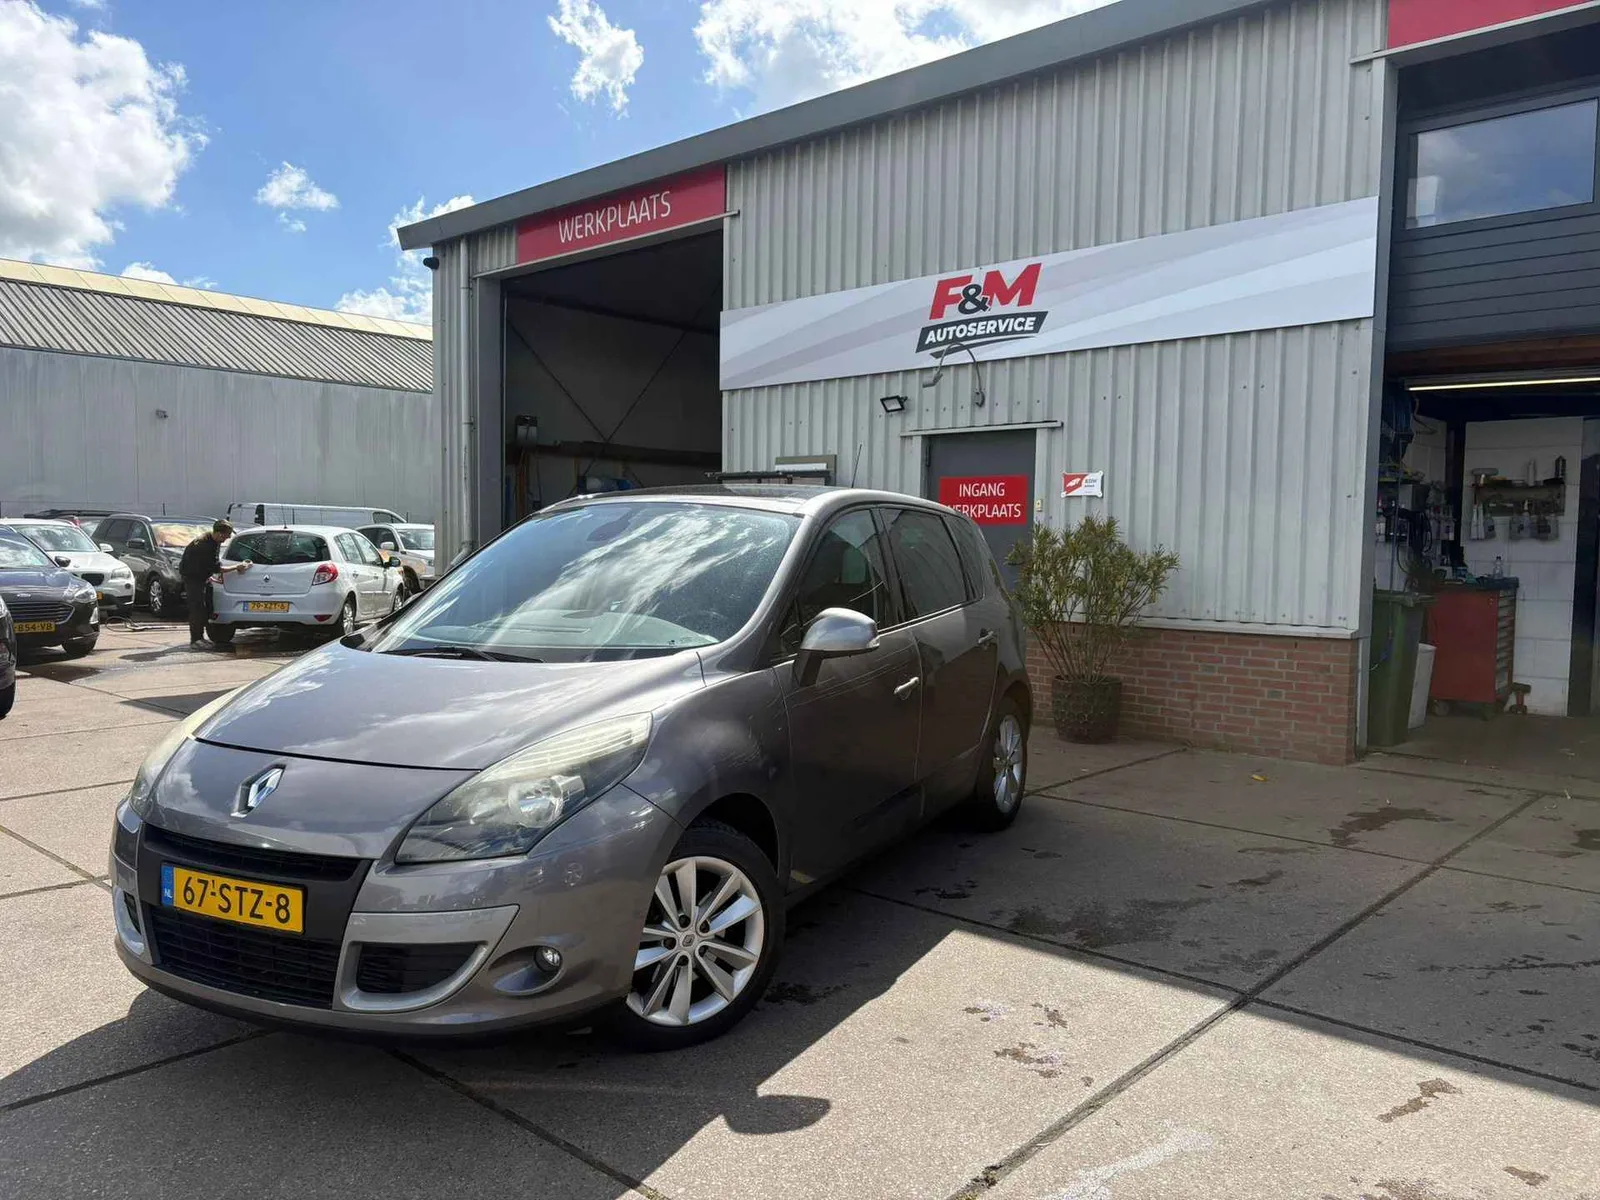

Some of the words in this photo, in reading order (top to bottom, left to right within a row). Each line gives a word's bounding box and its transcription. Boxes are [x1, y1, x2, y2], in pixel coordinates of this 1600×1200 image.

[558, 191, 671, 243] WERKPLAATS
[929, 262, 1042, 320] F&M
[924, 316, 1036, 345] AUTOSERVICE
[959, 482, 1005, 497] INGANG
[163, 887, 173, 899] NL
[183, 876, 291, 924] 67-STZ-8
